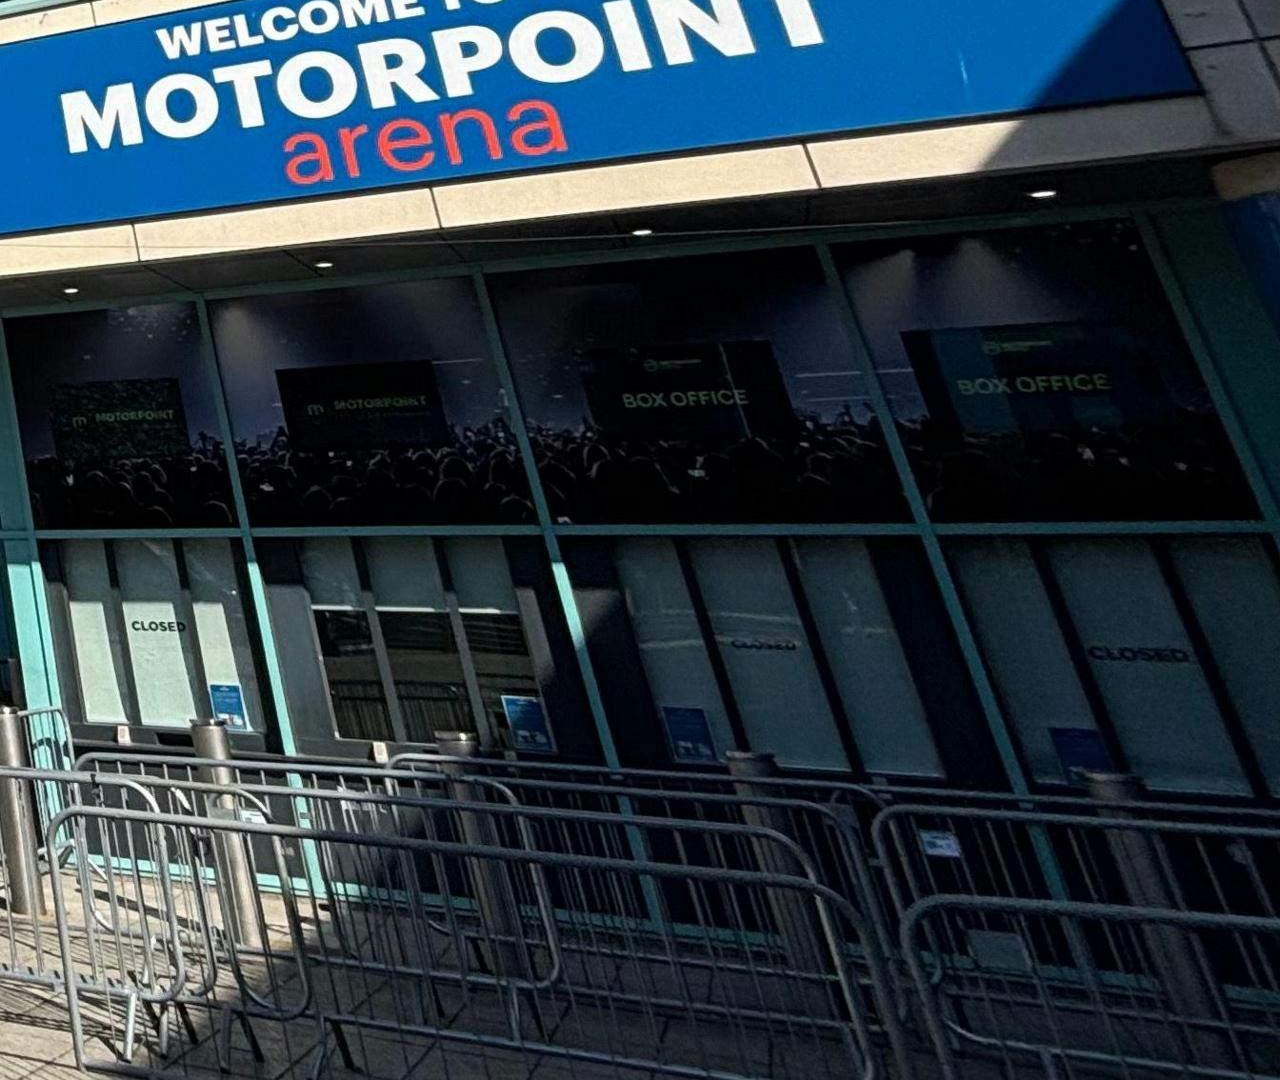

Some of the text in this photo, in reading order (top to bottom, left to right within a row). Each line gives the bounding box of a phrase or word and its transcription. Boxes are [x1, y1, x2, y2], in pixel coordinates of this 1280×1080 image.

[282, 98, 569, 185] arena
[622, 389, 750, 409] BOX OFFICE
[132, 620, 186, 632] CLOSED
[1087, 645, 1190, 663] CLOSED
